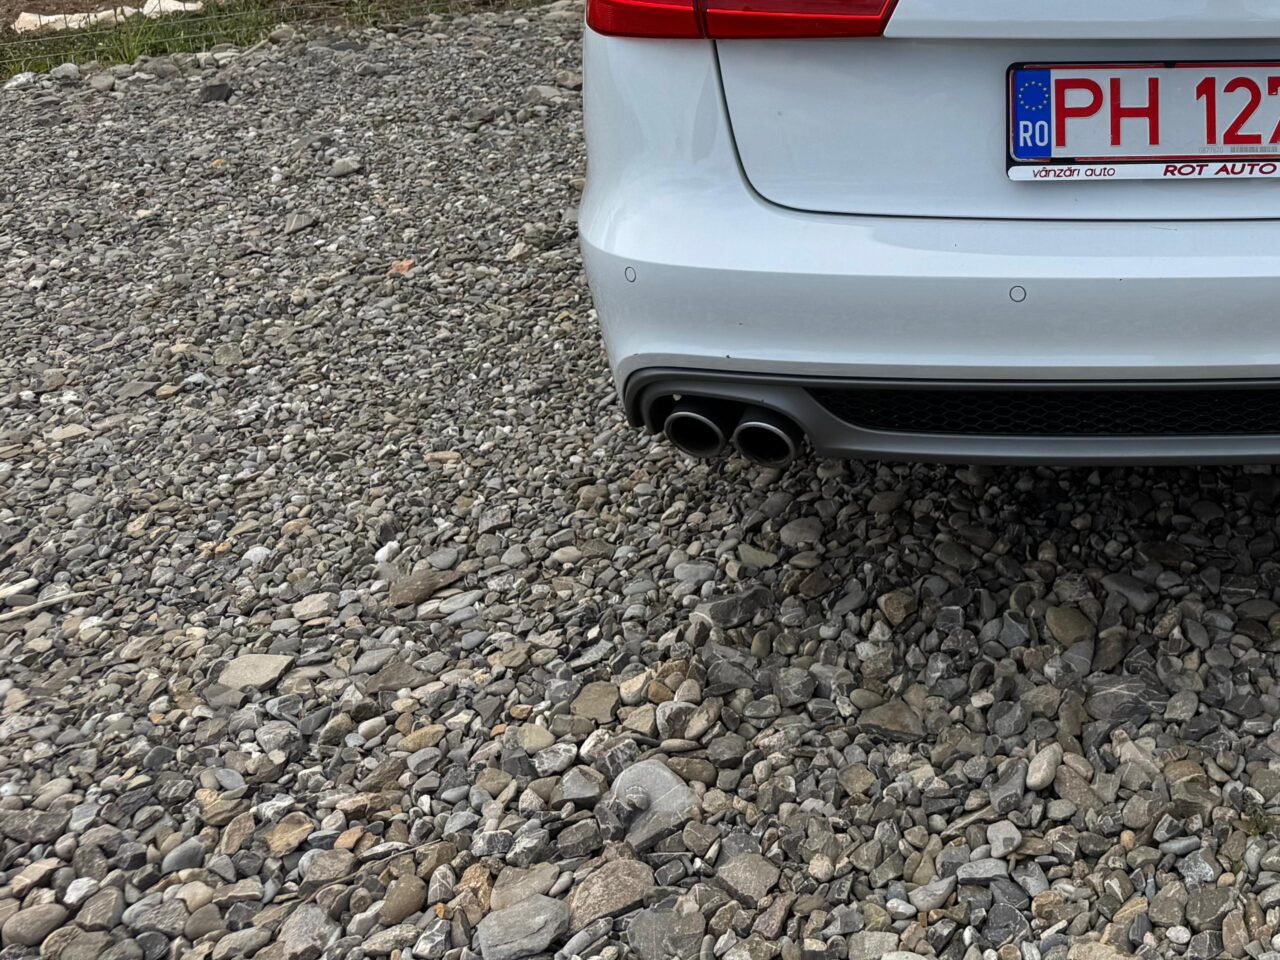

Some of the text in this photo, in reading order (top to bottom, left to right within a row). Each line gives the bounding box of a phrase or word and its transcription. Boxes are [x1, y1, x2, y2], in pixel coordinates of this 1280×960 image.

[1055, 77, 1159, 147] PH
[1019, 120, 1049, 147] RO
[1032, 164, 1080, 179] vânzări
[1085, 166, 1115, 178] auto
[1163, 164, 1208, 176] ROT
[1215, 163, 1277, 175] AUTO
